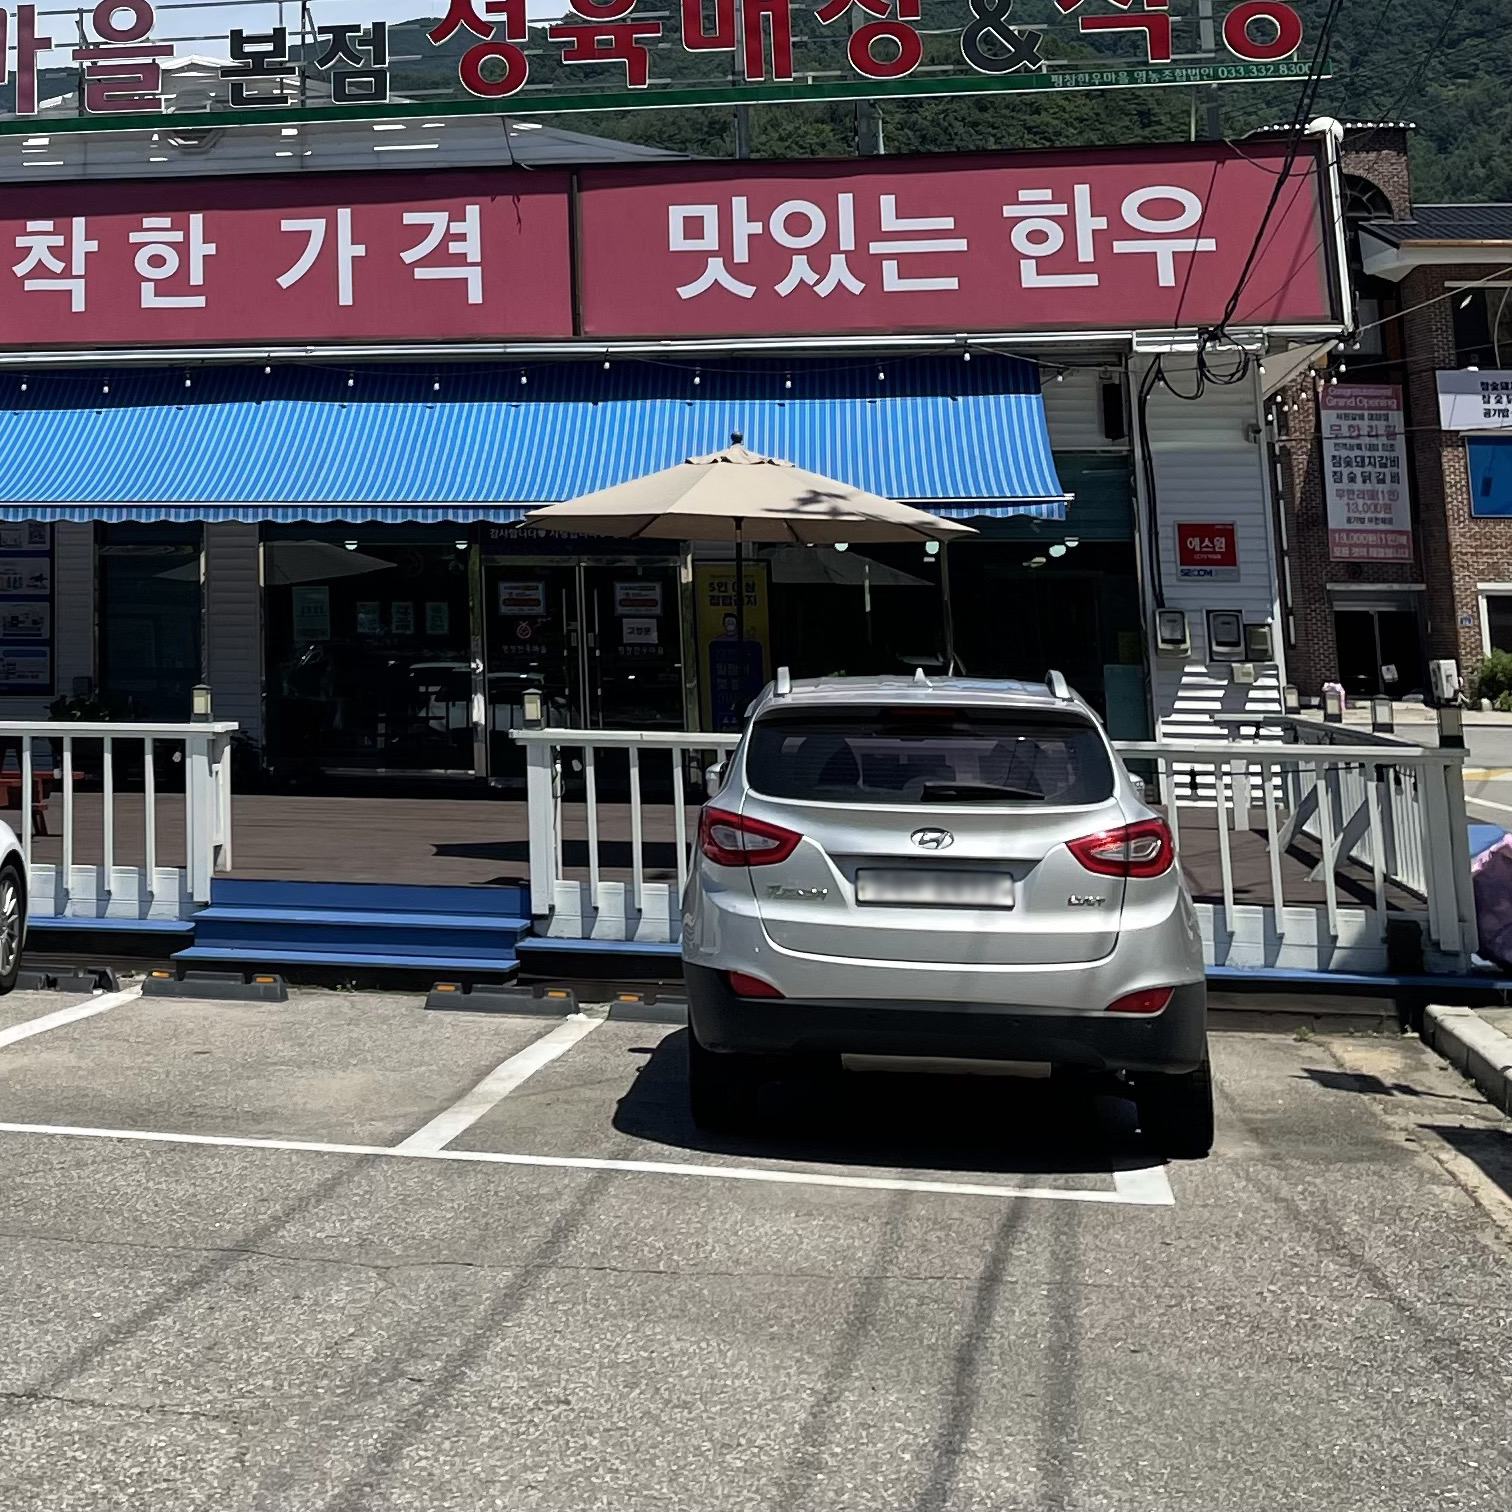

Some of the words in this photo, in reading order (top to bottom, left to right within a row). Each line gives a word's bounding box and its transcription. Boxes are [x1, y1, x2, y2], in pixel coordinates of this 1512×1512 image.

[219, 21, 390, 109] 본점
[1050, 70, 1130, 88] 평창한우마을
[1133, 67, 1215, 85] 영농조합법인
[11, 213, 217, 314] 착한
[275, 204, 484, 306] 가격
[668, 192, 969, 300] 맛있는
[1001, 183, 1218, 289] 한우
[1326, 396, 1355, 407] Grand
[1356, 397, 1397, 409] Opening
[1187, 536, 1226, 552] 에스원
